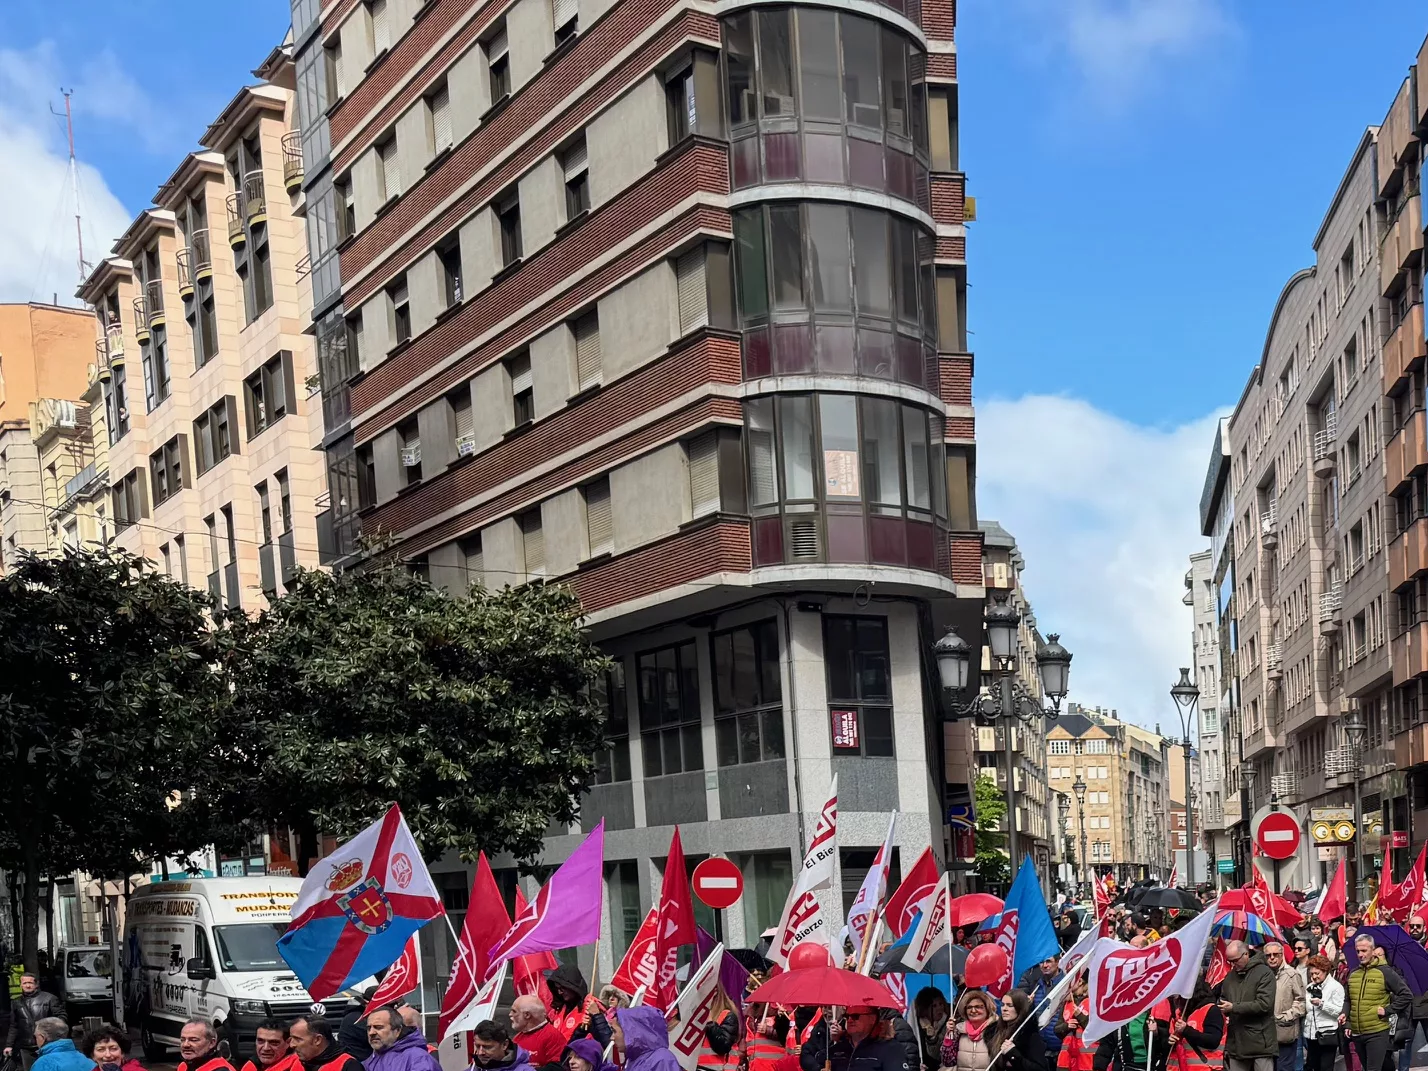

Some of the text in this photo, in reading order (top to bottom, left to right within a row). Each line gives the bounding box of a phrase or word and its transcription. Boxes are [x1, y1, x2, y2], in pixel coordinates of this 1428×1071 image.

[816, 845, 836, 861] Bie
[220, 892, 299, 900] TRANSPORT
[235, 904, 292, 912] MUDANZ
[794, 918, 824, 942] Bierzo
